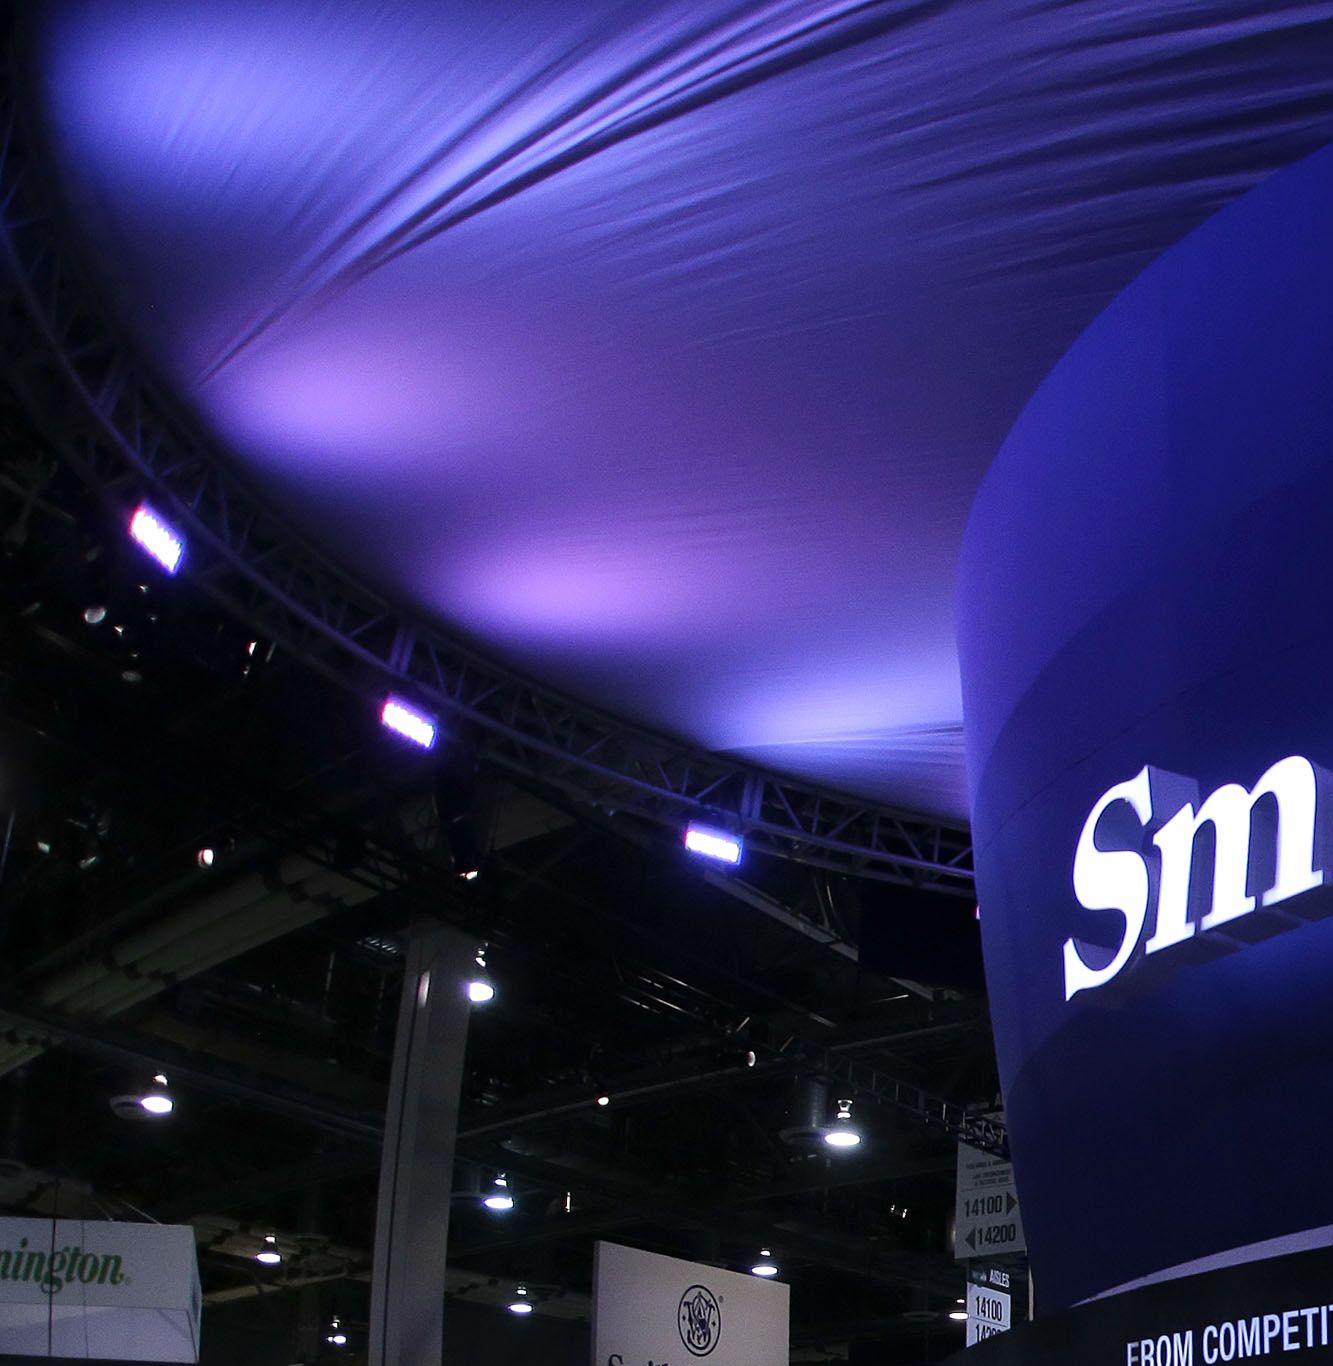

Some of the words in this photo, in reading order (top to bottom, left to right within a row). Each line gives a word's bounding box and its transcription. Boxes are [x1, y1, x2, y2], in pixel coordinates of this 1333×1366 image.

[964, 1195, 1002, 1218] 14100
[977, 1223, 1016, 1246] 14200
[0, 1237, 126, 1294] ington
[976, 1295, 1003, 1322] 14100
